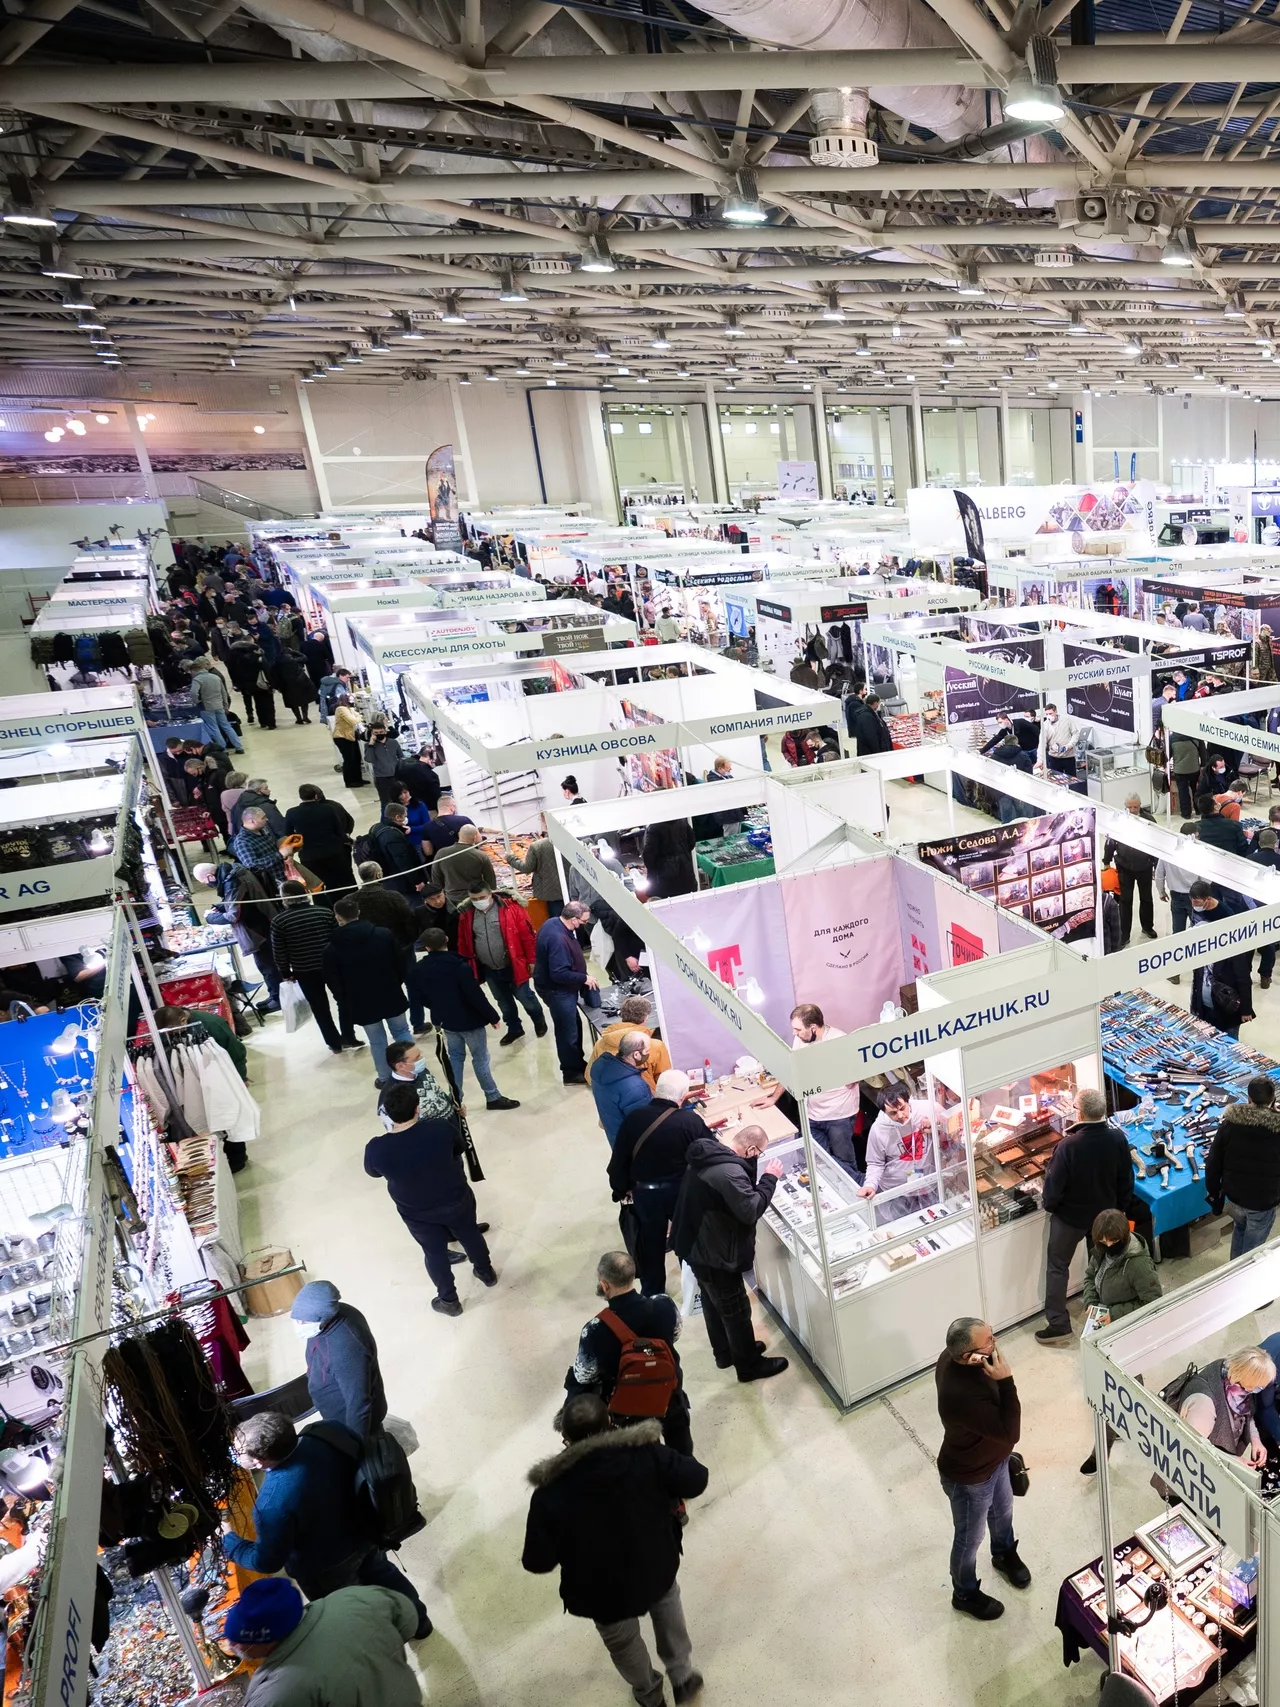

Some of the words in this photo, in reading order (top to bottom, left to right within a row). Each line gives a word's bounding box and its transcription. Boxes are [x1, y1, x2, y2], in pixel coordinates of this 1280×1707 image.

[310, 572, 364, 581] NEMOLOTOK.RU
[1088, 569, 1112, 577] ФАБРИКА
[68, 597, 127, 607] МАСТЕРСКАЯ
[485, 592, 524, 600] НАЗАРОВА
[927, 597, 948, 605] ARCOS
[382, 646, 448, 658] АКСЕССУАРЫ
[450, 643, 470, 653] ДЛЯ
[472, 641, 506, 650] ОХОТЫ
[1211, 647, 1247, 661] TSPROF
[968, 658, 990, 675] РУССКИЙ
[990, 665, 1006, 677] БУЛАТ
[1068, 668, 1105, 682] РУССКИЙ
[1106, 664, 1131, 677] БУЛАТ
[44, 715, 136, 738] СПОРЫШЕВ
[709, 717, 774, 735] КОМПАНИЯ
[776, 711, 813, 725] ЛИДЕР
[1199, 723, 1249, 745] МАСТЕРСКАЯ
[536, 743, 598, 761] КУЗНИЦА
[600, 733, 657, 751] ОВСОВА
[920, 844, 954, 859] Ножи
[958, 834, 997, 851] Седова
[1001, 828, 1023, 841] А.А.
[18, 880, 51, 897] AG
[813, 927, 832, 938] ДЛЯ
[832, 917, 870, 934] КАЖДОГО
[832, 931, 855, 944] ДОМА
[1137, 919, 1258, 975] ВОРСМЕНСКИЙ
[825, 961, 849, 970] СДЕЛАНО
[675, 953, 743, 1031] TOCHILKAZHUK.RU
[857, 988, 1051, 1065] TOCHILKAZHUK.RU
[803, 1085, 822, 1098] N4.6
[1103, 1369, 1218, 1496] РОСПИСЬ
[1101, 1393, 1132, 1441] НА
[1137, 1430, 1222, 1530] ЭМАЛИ
